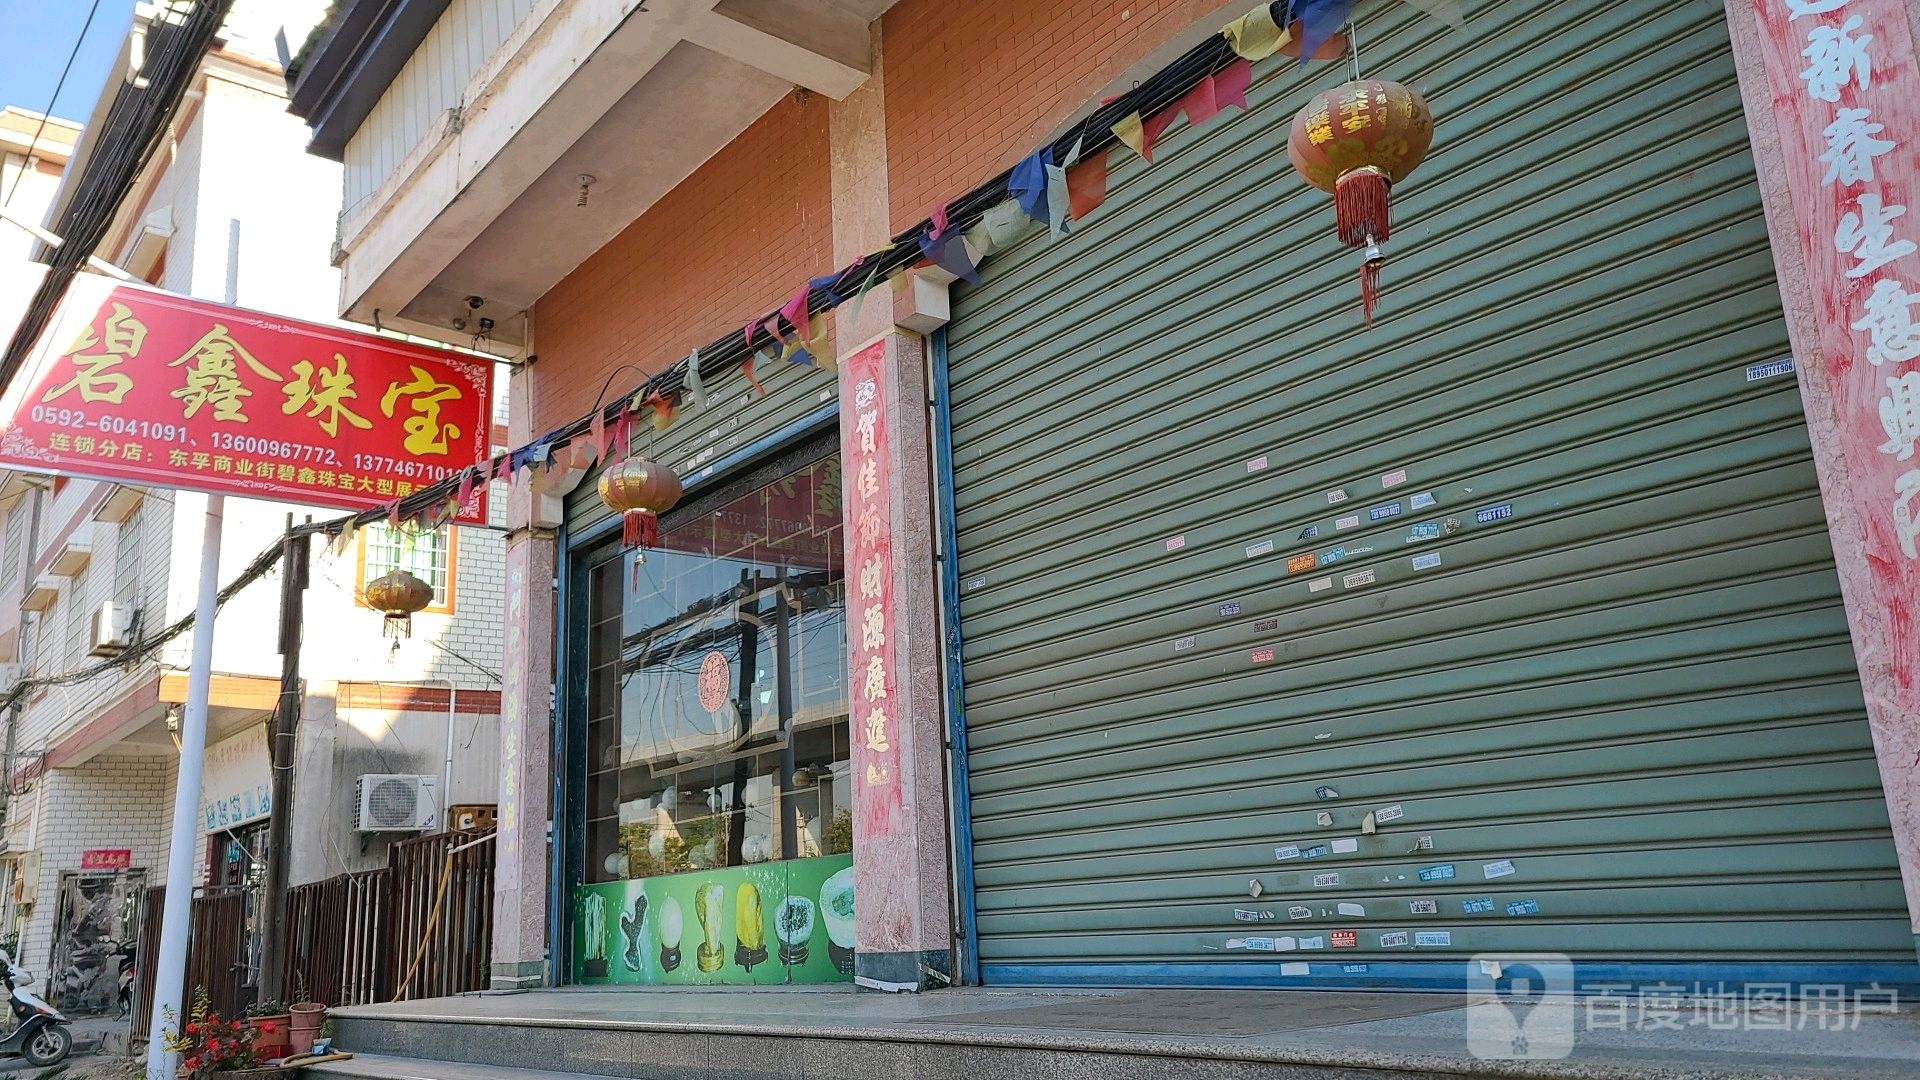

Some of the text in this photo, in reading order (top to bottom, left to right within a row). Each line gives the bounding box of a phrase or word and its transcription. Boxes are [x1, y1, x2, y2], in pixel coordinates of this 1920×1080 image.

[41, 302, 462, 457] 碧鑫珠宝
[353, 453, 463, 481] 1377467101
